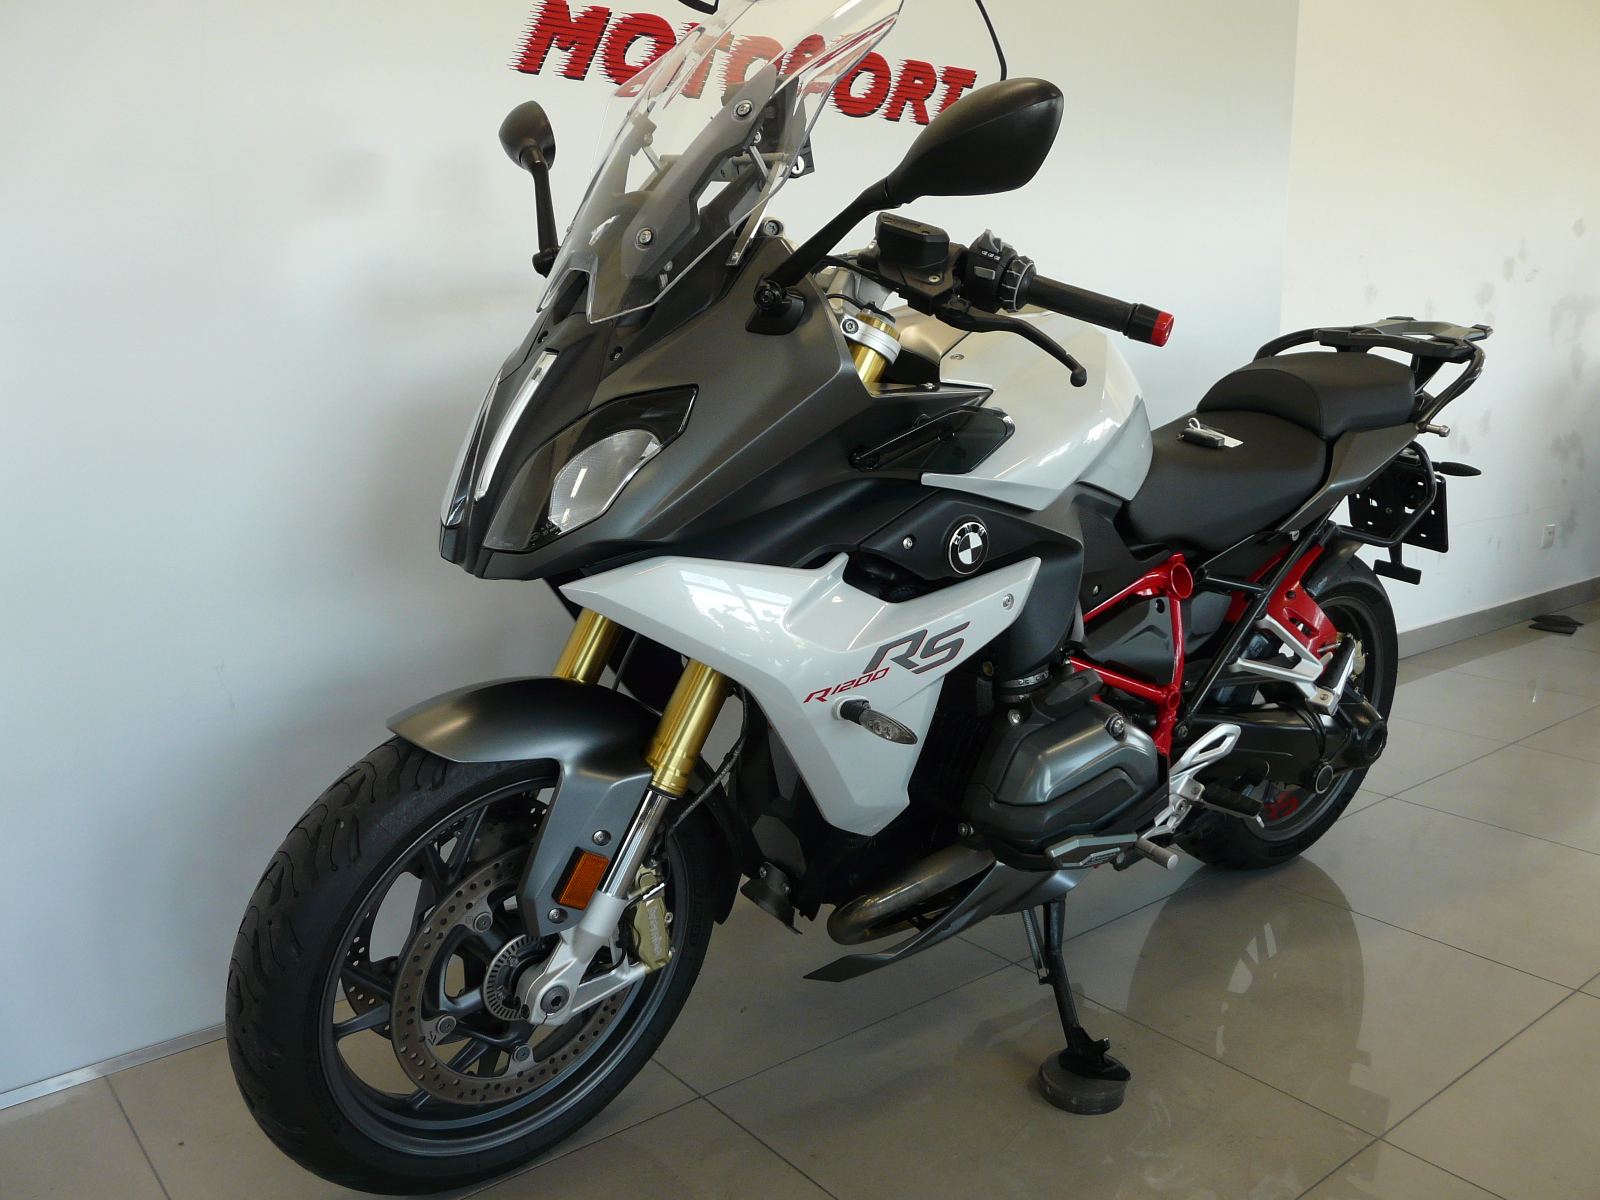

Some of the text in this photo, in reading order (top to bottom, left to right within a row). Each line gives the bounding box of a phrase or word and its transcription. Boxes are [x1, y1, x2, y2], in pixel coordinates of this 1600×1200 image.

[952, 523, 985, 546] BMW
[803, 621, 970, 703] R1200 RS
